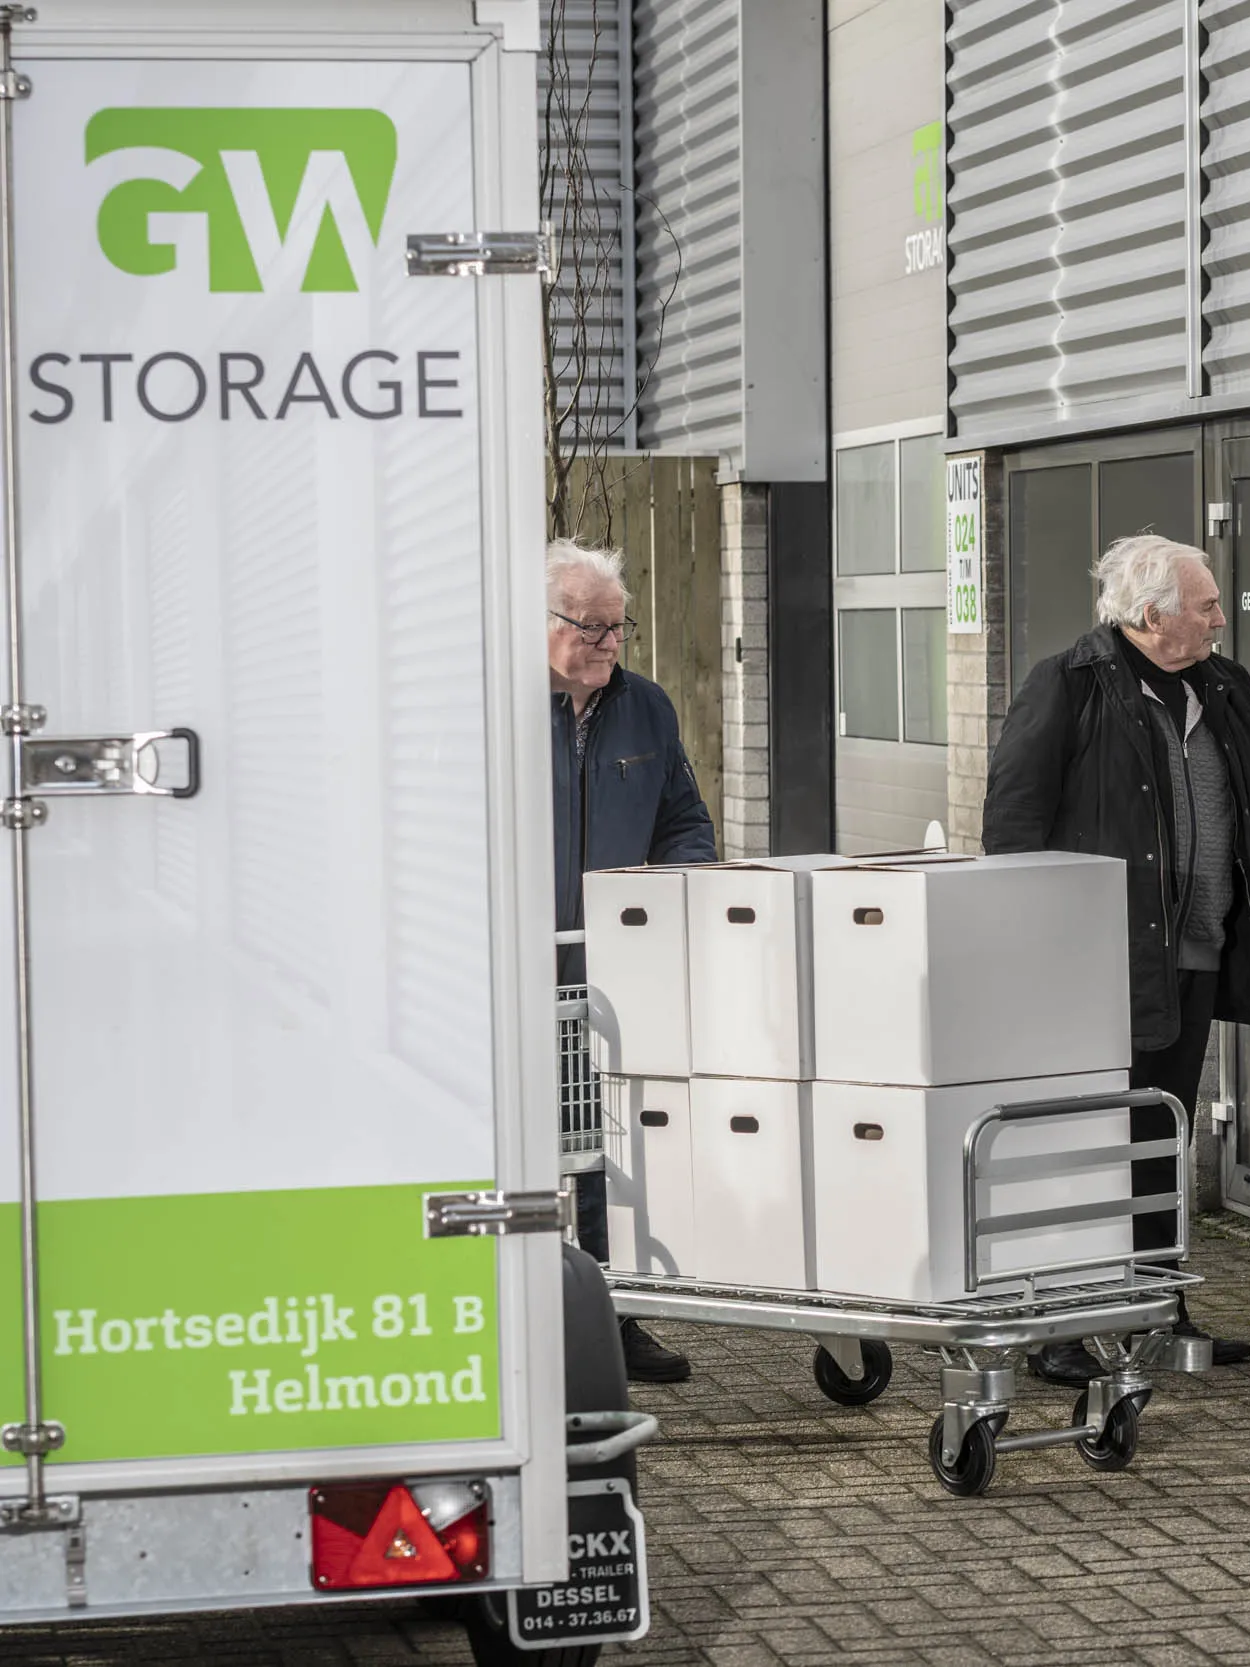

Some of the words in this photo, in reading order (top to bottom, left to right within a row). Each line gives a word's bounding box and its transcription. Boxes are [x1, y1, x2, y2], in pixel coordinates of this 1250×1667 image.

[86, 145, 390, 293] GW
[905, 226, 943, 275] STORA
[29, 350, 463, 425] STORAGE
[947, 460, 979, 503] UNITS
[955, 513, 976, 553] 024
[959, 558, 972, 579] T/M
[956, 583, 977, 623] 038
[54, 1294, 357, 1357] Hortsedijk
[372, 1293, 432, 1338] 81
[453, 1295, 485, 1334] B
[229, 1355, 487, 1416] Helmond
[580, 1563, 635, 1580] TRAILER
[536, 1584, 621, 1609] DESSEL
[523, 1615, 554, 1631] 014
[567, 1608, 638, 1628] 37.36.67
